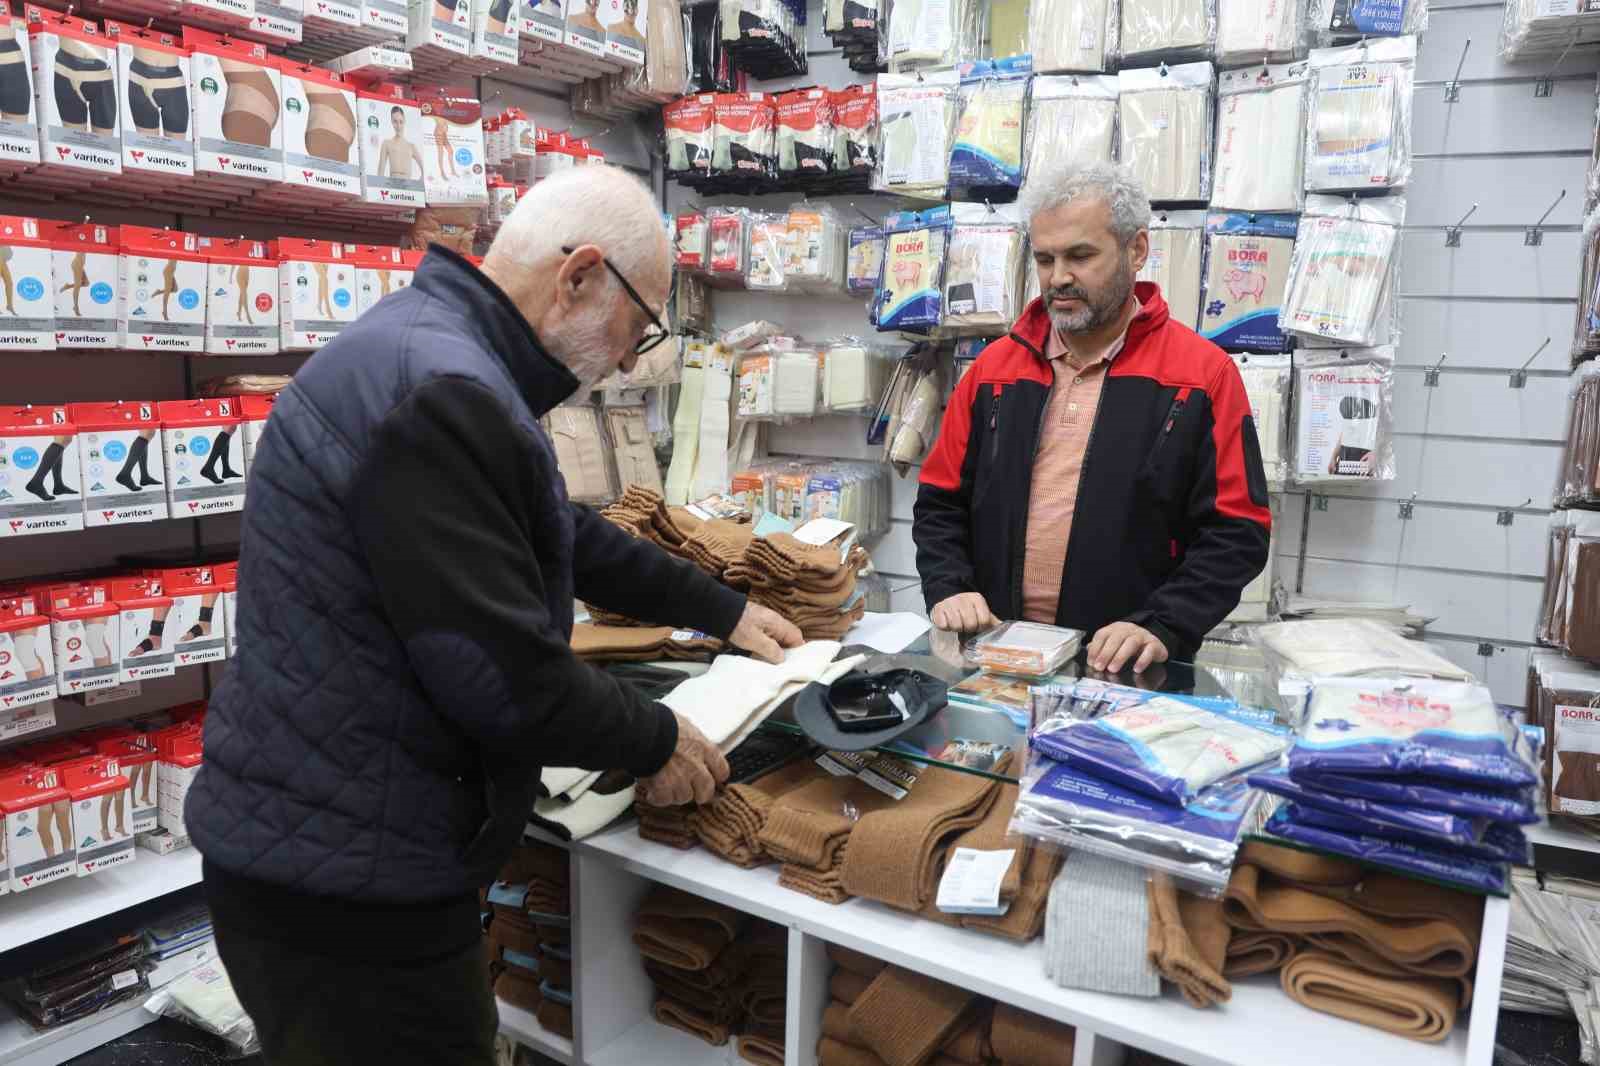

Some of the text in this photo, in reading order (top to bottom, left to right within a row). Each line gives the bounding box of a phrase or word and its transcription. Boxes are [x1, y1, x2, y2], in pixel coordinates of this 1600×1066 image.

[0, 143, 31, 154] iteks
[73, 151, 115, 166] variteks
[146, 154, 188, 168] variteks
[231, 162, 269, 174] variteks
[1228, 249, 1268, 263] BORA
[0, 335, 38, 345] ariteks
[67, 335, 106, 344] variteks
[155, 338, 190, 348] variteks
[200, 499, 235, 511] variteks
[116, 507, 153, 520] variteks
[25, 519, 68, 530] variteks
[1561, 709, 1593, 721] BORA
